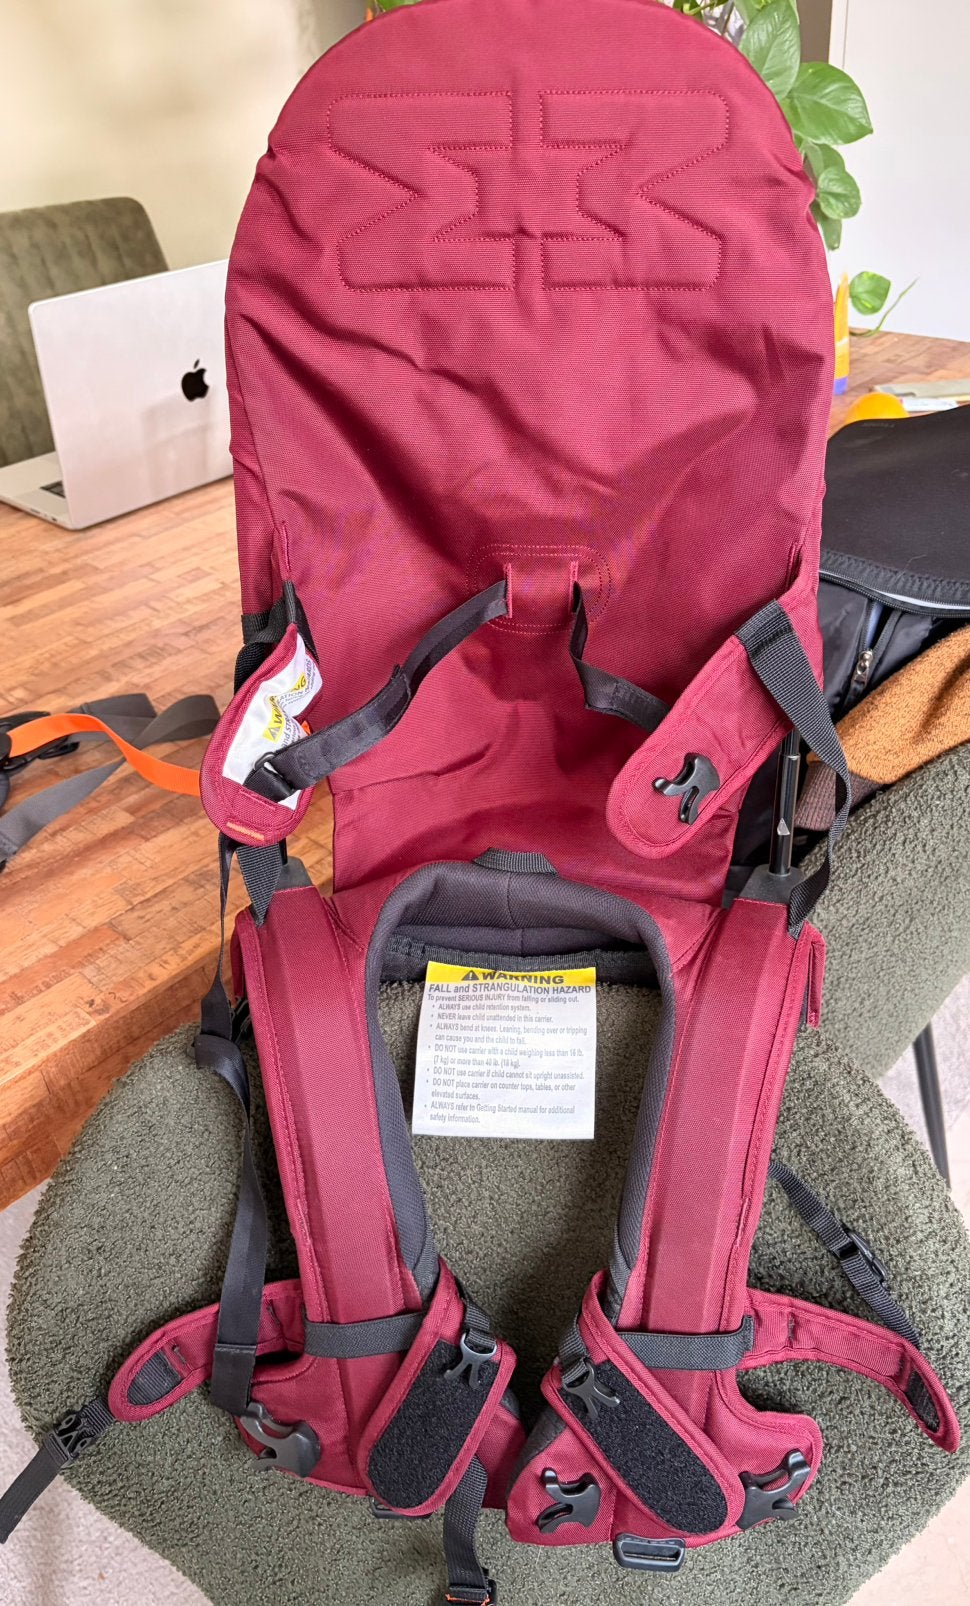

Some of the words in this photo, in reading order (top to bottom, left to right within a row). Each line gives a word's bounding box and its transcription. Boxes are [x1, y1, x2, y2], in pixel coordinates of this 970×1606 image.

[481, 971, 565, 985] WARNING
[428, 984, 452, 993] FALL
[453, 984, 470, 993] and
[472, 982, 550, 995] STRANGULATION
[552, 985, 592, 994] HAZARD
[435, 994, 457, 1003] prevent
[458, 994, 484, 1002] SERIOUS
[507, 994, 521, 1002] from
[521, 994, 540, 1005] falling
[547, 996, 568, 1004] sliding
[437, 1012, 456, 1020] NEVER
[486, 1014, 516, 1022] unattended
[435, 1022, 459, 1030] ALWAYS
[460, 1023, 474, 1031] bend
[523, 1026, 545, 1036] bending
[566, 1026, 588, 1036] tripping
[463, 1036, 474, 1044] you
[495, 1036, 508, 1044] child
[434, 1043, 444, 1052] DO
[444, 1044, 457, 1053] NOT
[457, 1046, 468, 1054] use
[468, 1046, 486, 1055] carrier
[504, 1048, 518, 1056] child
[519, 1048, 544, 1058] weighing
[544, 1049, 555, 1057] less
[556, 1049, 569, 1057] than
[472, 1057, 485, 1066] than
[433, 1066, 442, 1075] DO
[443, 1067, 456, 1076] NOT
[467, 1069, 485, 1077] carrier
[491, 1070, 505, 1078] child
[533, 1072, 553, 1081] upright
[553, 1072, 584, 1080] unassisted.
[432, 1077, 441, 1086] DO
[442, 1078, 455, 1087] NOT
[455, 1080, 471, 1089] place
[471, 1080, 489, 1089] carrier
[498, 1082, 520, 1090] counter
[560, 1083, 576, 1091] other
[431, 1089, 454, 1099] elevated
[455, 1091, 480, 1100] surfaces.
[430, 1100, 455, 1110] ALWAYS
[455, 1102, 469, 1111] refer
[469, 1103, 476, 1112] to
[476, 1103, 496, 1114] Getting
[497, 1104, 517, 1113] Started
[517, 1105, 538, 1113] manual
[539, 1105, 547, 1113] for
[548, 1105, 576, 1114] additional
[430, 1112, 447, 1123] safety
[447, 1113, 480, 1123] information.
